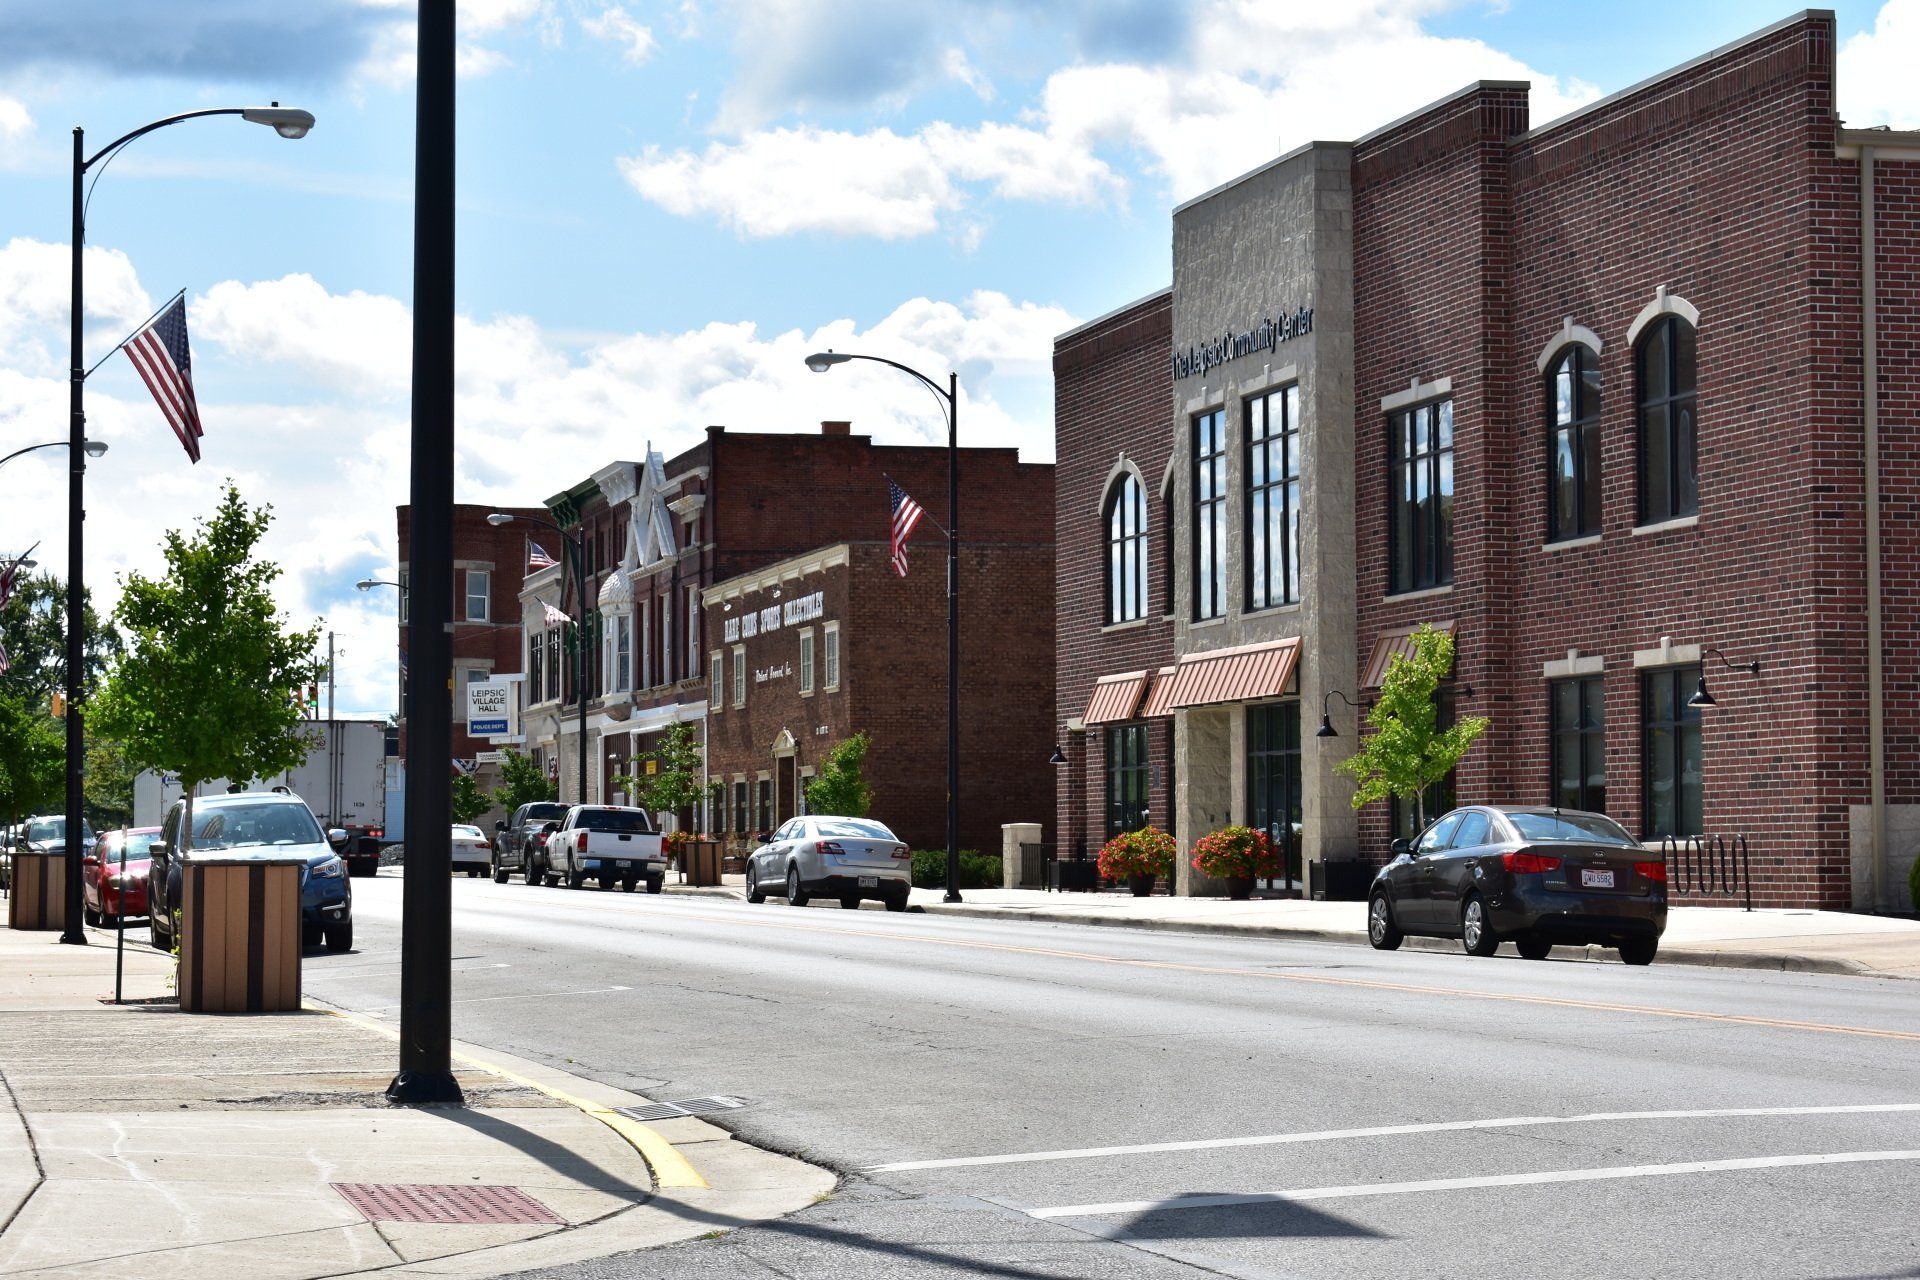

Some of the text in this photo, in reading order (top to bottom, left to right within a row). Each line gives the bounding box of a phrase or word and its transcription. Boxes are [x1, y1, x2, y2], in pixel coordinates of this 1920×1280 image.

[1189, 337, 1222, 378] Leipsic
[1222, 318, 1277, 362] Community
[1278, 306, 1314, 342] Center
[761, 605, 781, 634] SPORTS
[784, 591, 823, 627] COLLECTIBLES
[472, 689, 505, 697] LEIPSIC
[472, 697, 505, 705] VILLAGE
